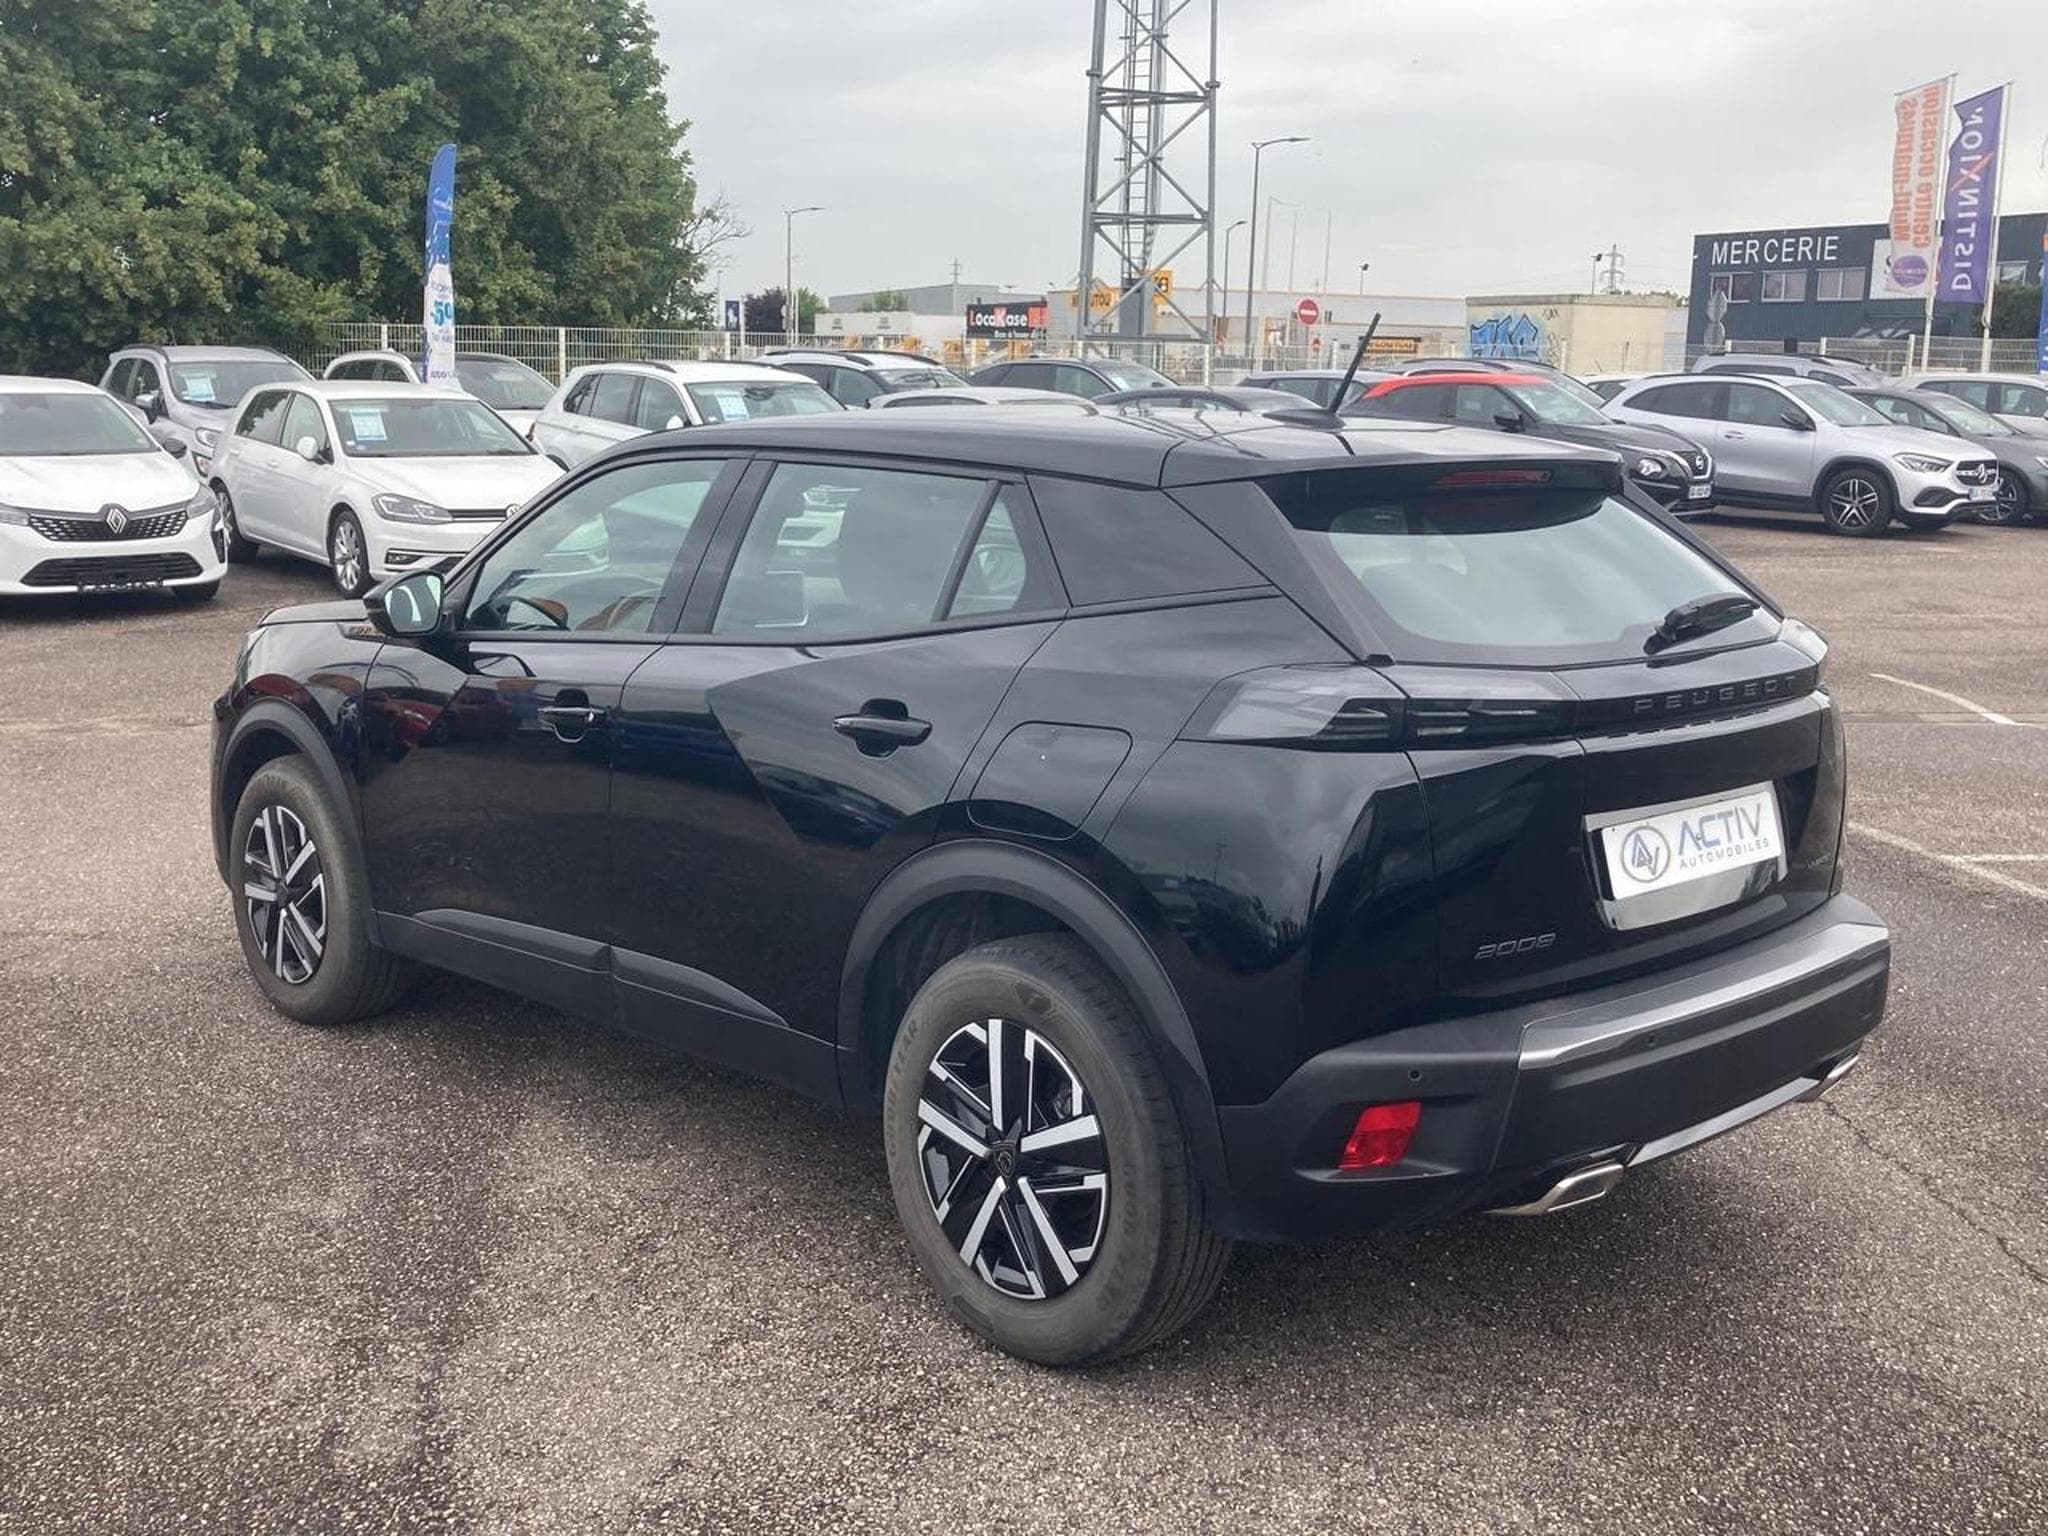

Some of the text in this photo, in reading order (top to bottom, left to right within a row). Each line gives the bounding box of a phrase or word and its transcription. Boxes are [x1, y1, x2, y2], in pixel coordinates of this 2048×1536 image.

[1711, 235, 1840, 266] MERCERIE
[1633, 675, 1796, 714] PEUGEOT
[1678, 803, 1763, 857] ACTIV
[1679, 837, 1770, 870] AUTOMOBILES
[1473, 932, 1556, 960] 2008
